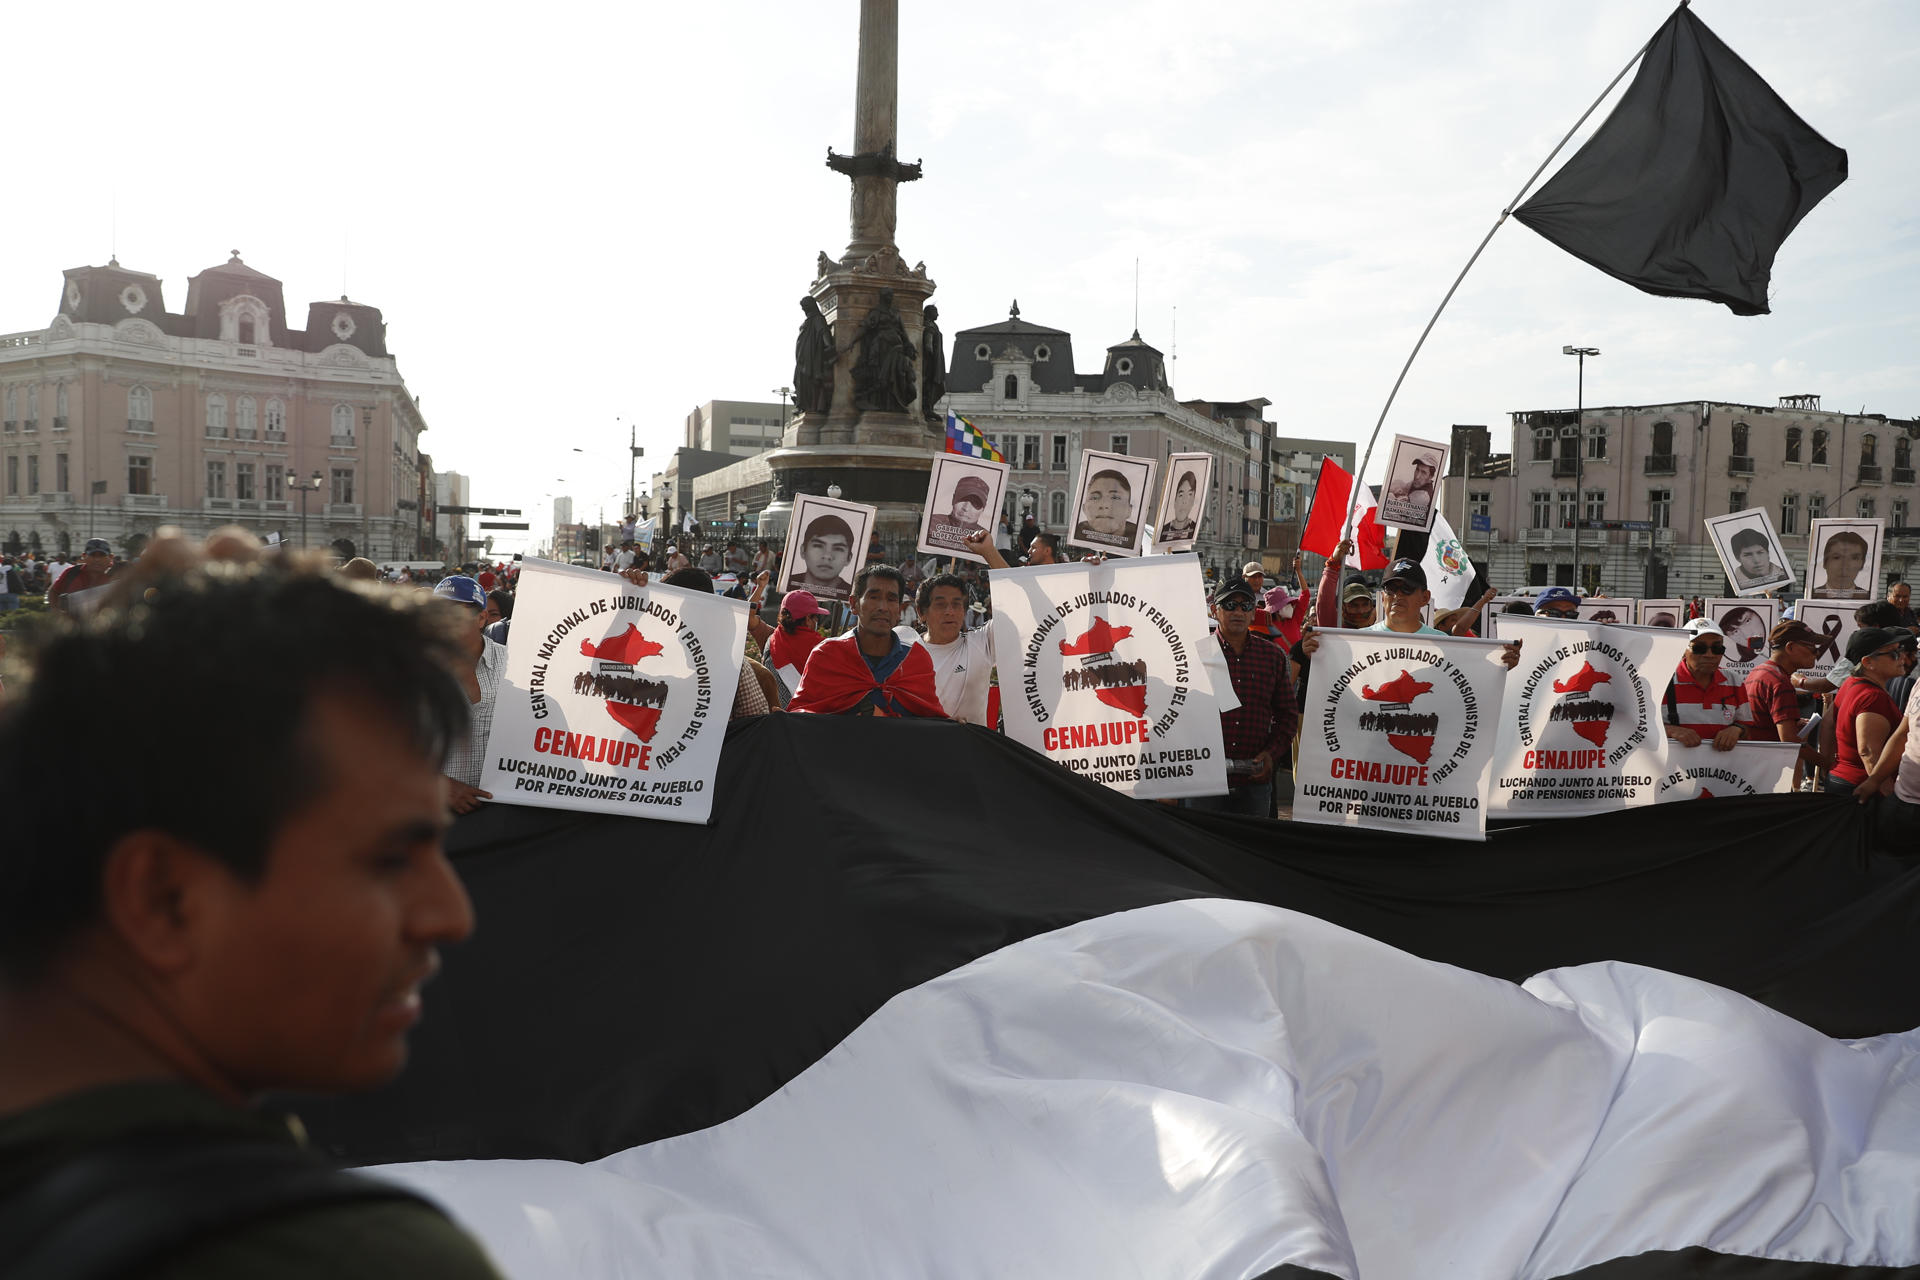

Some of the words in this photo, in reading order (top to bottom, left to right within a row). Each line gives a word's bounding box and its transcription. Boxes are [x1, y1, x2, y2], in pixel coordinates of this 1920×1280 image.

[932, 531, 954, 540] LOPEZ
[936, 524, 962, 534] GABRIEL
[590, 599, 608, 615] DE
[611, 596, 677, 627] JUBILADOS
[1056, 601, 1073, 618] DE
[1075, 592, 1136, 609] JUBILADOS
[1138, 601, 1147, 612] Y
[538, 608, 589, 659] NACIONAL
[675, 622, 687, 633] Y
[1024, 615, 1059, 667] NACIONAL
[1146, 607, 1189, 683] PENSIONISTAS
[1572, 641, 1623, 662] JUBILADOS
[1366, 652, 1382, 665] DE
[1384, 648, 1444, 667] JUBILADOS
[1556, 647, 1570, 661] DE
[1622, 657, 1629, 667] Y
[682, 630, 710, 719] PENSIONISTAS
[1443, 662, 1452, 672] Y
[1328, 661, 1367, 705] NACIONAL
[1521, 657, 1557, 700] NACIONAL
[530, 661, 548, 720] CENTRAL
[1024, 671, 1049, 722] CENTRAL
[1170, 686, 1188, 706] DEL
[1627, 664, 1648, 733] PENSIONISTAS
[1449, 668, 1477, 739] PENSIONISTAS
[682, 721, 703, 742] DEL
[1153, 708, 1178, 739] PERÚ
[1324, 707, 1340, 752] CENTRAL
[1519, 702, 1533, 746] CENTRAL
[1043, 720, 1149, 750] CENAJUPE
[1628, 730, 1645, 744] DEL
[534, 727, 652, 770] CENAJUPE
[656, 741, 686, 770] PERÚ
[1093, 755, 1136, 768] JUNTO
[1140, 752, 1156, 765] AL
[1160, 748, 1211, 762] PUEBLO
[1453, 741, 1472, 758] DEL
[1523, 749, 1606, 770] CENAJUPE
[1609, 742, 1633, 765] PERÚ
[499, 758, 576, 782] LUCHANDO
[580, 772, 627, 789] JUNTO
[630, 780, 647, 791] AL
[652, 780, 703, 794] PUEBLO
[1145, 764, 1193, 780] DIGNAS
[1331, 758, 1428, 786] CENAJUPE
[1432, 759, 1458, 784] PERÚ
[1500, 778, 1556, 788] LUCHANDO
[1559, 778, 1594, 787] JUNTO
[1596, 777, 1608, 786] AL
[1612, 776, 1651, 786] PUEBLO
[1669, 772, 1683, 784] DE
[1686, 768, 1737, 784] JUBILADOS
[1737, 779, 1746, 788] Y
[515, 777, 544, 792] POR
[548, 783, 626, 801] PENSIONES
[629, 793, 682, 806] DIGNAS
[1304, 785, 1368, 801] LUCHANDO
[1371, 792, 1411, 805] JUNTO
[1414, 795, 1428, 806] AL
[1432, 795, 1478, 809] PUEBLO
[1512, 790, 1534, 800] POR
[1537, 790, 1595, 799] PENSIONES
[1599, 789, 1636, 798] DIGNAS
[1319, 801, 1342, 814] POR
[1346, 804, 1412, 820] PENSIONES
[1416, 809, 1460, 823] DIGNAS
